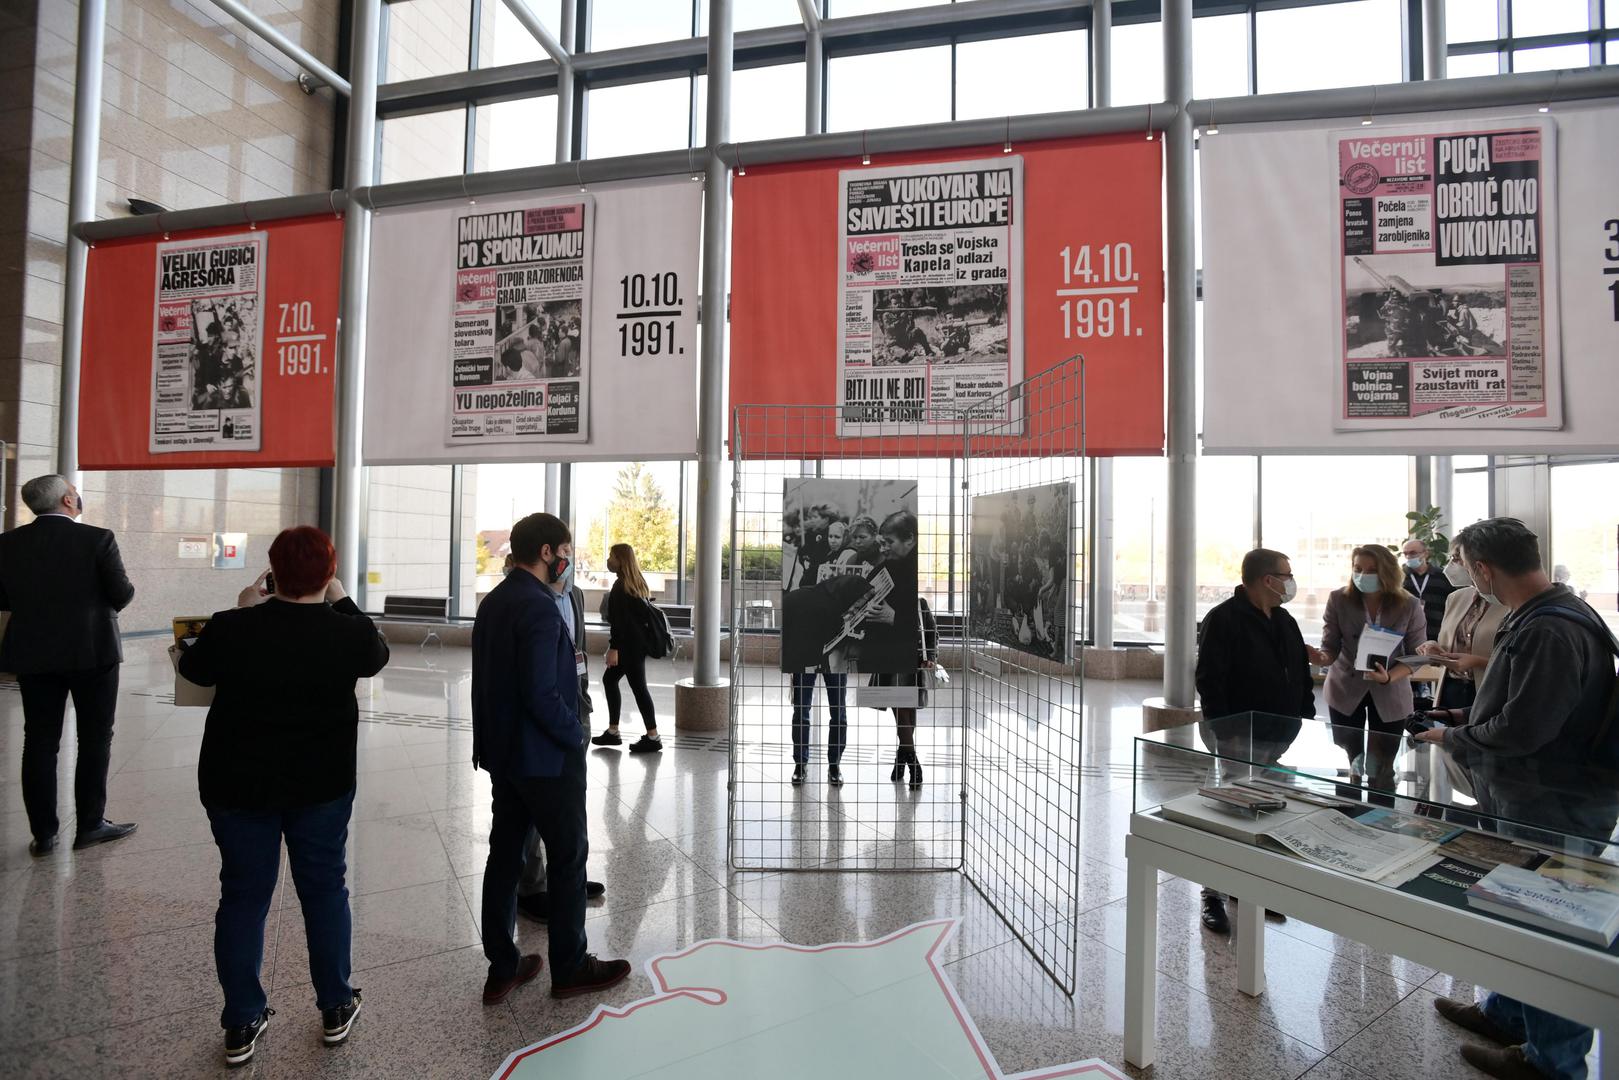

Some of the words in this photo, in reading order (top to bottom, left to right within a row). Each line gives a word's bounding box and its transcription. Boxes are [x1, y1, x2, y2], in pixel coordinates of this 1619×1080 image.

[1349, 138, 1426, 159] Večernji
[1440, 137, 1490, 174] PUCA
[1396, 156, 1426, 174] list
[888, 174, 978, 204] VUKOVAR
[984, 171, 1012, 196] NA
[1437, 176, 1498, 218] OBRUČ
[1502, 178, 1536, 215] OKO
[1378, 200, 1406, 212] Počela
[848, 202, 930, 232] SAVJESTI
[934, 197, 1008, 226] EUROPE
[1378, 215, 1414, 228] zamjena
[460, 212, 522, 242] MINAMA
[957, 236, 998, 251] Vojska
[1378, 229, 1430, 243] zarobljenika
[1440, 220, 1536, 258] VUKOVARA
[459, 243, 478, 267] PO
[482, 232, 582, 265] SPORAZUMU!
[848, 238, 898, 253] Večernji
[901, 241, 938, 256] Tresla
[940, 244, 954, 255] se
[162, 252, 206, 272] VELIKI
[210, 247, 255, 268] GUBICI
[878, 254, 898, 266] list
[904, 256, 950, 273] Kapela
[957, 252, 993, 264] odlazi
[1060, 242, 1139, 284] 14.10.
[162, 267, 235, 290] AGRESORA
[458, 271, 496, 285] Večernji
[497, 271, 524, 288] OTPOR
[527, 266, 584, 285] RAZORENOGA
[956, 268, 966, 280] iz
[971, 266, 1007, 281] grada
[480, 286, 495, 296] list
[497, 288, 526, 304] GRADA
[620, 272, 683, 308] 10.10.
[279, 301, 315, 333] 7.10.
[454, 319, 489, 330] Bumerang
[1060, 298, 1142, 339] 1991.
[454, 327, 493, 338] slovenskog
[619, 321, 683, 356] 1991.
[454, 339, 474, 347] tolara
[278, 344, 328, 376] 1991.
[1362, 370, 1393, 382] Vojna
[1423, 368, 1460, 380] Svijet
[1465, 368, 1498, 378] mora
[846, 378, 866, 400] BITI
[870, 378, 883, 400] ILI
[886, 378, 900, 399] NE
[904, 378, 925, 399] BITI
[1352, 381, 1392, 392] bolnica
[1415, 379, 1479, 390] zaustaviti
[1486, 379, 1505, 389] rat
[457, 393, 472, 410] YU
[476, 390, 543, 410] nepoželjna
[1357, 391, 1399, 402] vojarna
[548, 406, 576, 415] Korduna
